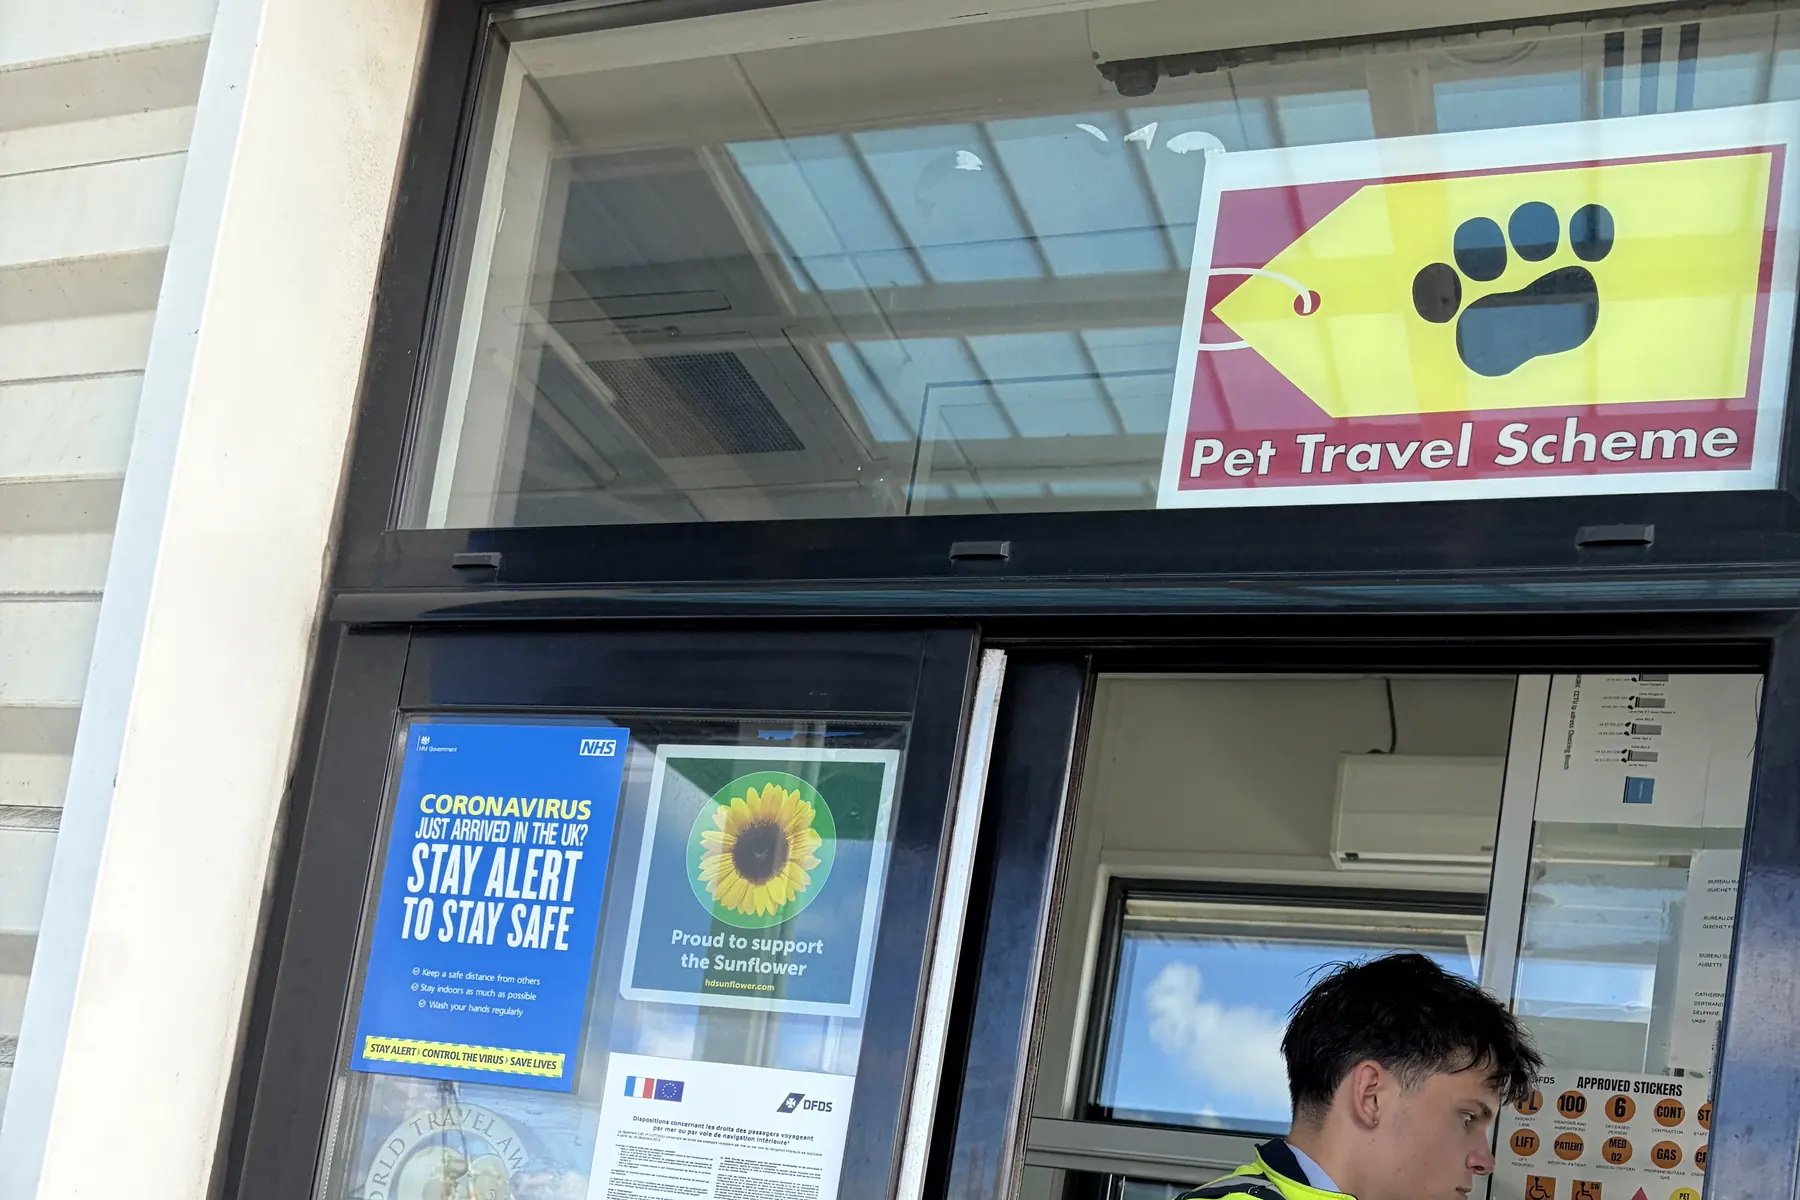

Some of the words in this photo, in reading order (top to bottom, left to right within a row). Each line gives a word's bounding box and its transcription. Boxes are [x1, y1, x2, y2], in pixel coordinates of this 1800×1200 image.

[1189, 437, 1277, 478] Pet
[1295, 420, 1474, 475] Travel
[1493, 416, 1739, 467] Scheme
[581, 740, 614, 755] NHS
[420, 793, 592, 820] CORONAVIRUS
[415, 817, 450, 840] JUST
[450, 818, 510, 843] ARRIVED
[513, 820, 529, 844] IN
[532, 822, 559, 846] THE
[560, 823, 589, 846] UK?
[406, 842, 484, 896] STAY
[484, 846, 584, 902] ALERT
[401, 896, 434, 941] TO
[438, 898, 504, 945] STAY
[506, 903, 575, 951] SAFE
[671, 929, 725, 948] Proud
[728, 934, 748, 950] to
[752, 938, 824, 956] support
[681, 954, 710, 970] the
[714, 954, 807, 976] Sunflower
[422, 968, 440, 978] Keep
[448, 970, 464, 980] safe
[465, 971, 495, 982] distance
[497, 974, 515, 984] from
[517, 976, 540, 986] others
[704, 979, 775, 992] hdsunflower.com
[420, 983, 435, 995] Stay
[437, 984, 464, 996] indoors
[465, 988, 474, 996] as
[475, 988, 496, 998] much
[507, 990, 537, 1001] possible
[429, 1000, 448, 1010] Wash
[450, 1003, 467, 1012] your
[469, 1004, 490, 1014] hands
[492, 1006, 523, 1018] regularly
[370, 1043, 391, 1054] STAY
[391, 1044, 417, 1056] ALERT
[422, 1048, 460, 1061] CONTROL
[462, 1052, 479, 1063] THE
[479, 1053, 504, 1065] VIRUS
[510, 1056, 532, 1068] SAVE
[532, 1058, 557, 1070] LIVES
[1577, 1076, 1630, 1092] APPROVED
[1633, 1081, 1682, 1096] STICKERS
[803, 1098, 833, 1113] DFDS
[1560, 1094, 1586, 1112] 100
[1614, 1098, 1626, 1118] 6
[1656, 1106, 1682, 1119] CONT
[408, 1108, 496, 1138] TRAVEL
[632, 1115, 670, 1126] Dispositions
[670, 1120, 704, 1129] concernant
[716, 1124, 734, 1132] droits
[748, 1129, 780, 1138] passagers
[780, 1132, 814, 1142] voyageant
[723, 1133, 755, 1142] navigation
[1515, 1136, 1535, 1148] LIFT
[1608, 1138, 1627, 1149] MED
[1656, 1149, 1676, 1160] GAS
